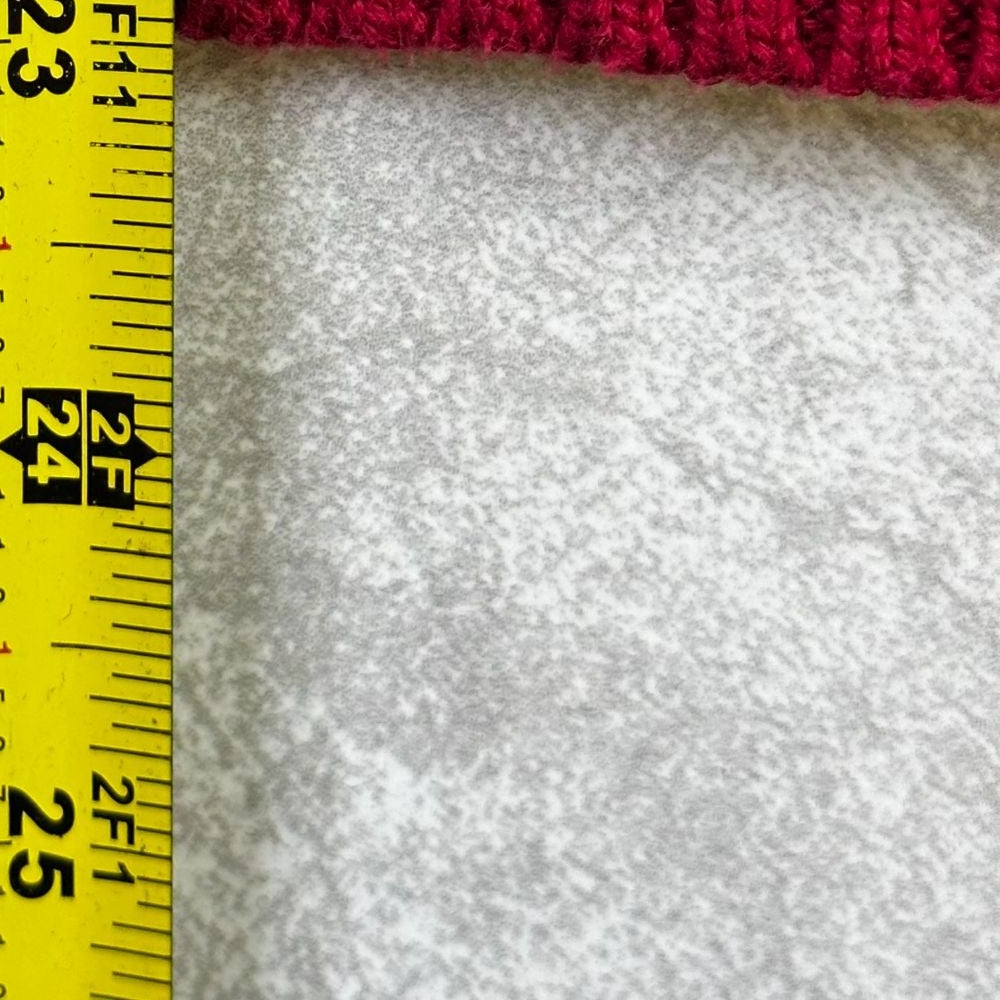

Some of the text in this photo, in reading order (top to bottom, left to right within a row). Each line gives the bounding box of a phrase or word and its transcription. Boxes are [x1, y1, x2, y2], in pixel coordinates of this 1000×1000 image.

[27, 398, 80, 484] 24
[91, 409, 131, 493] 2F
[8, 786, 75, 900] 25
